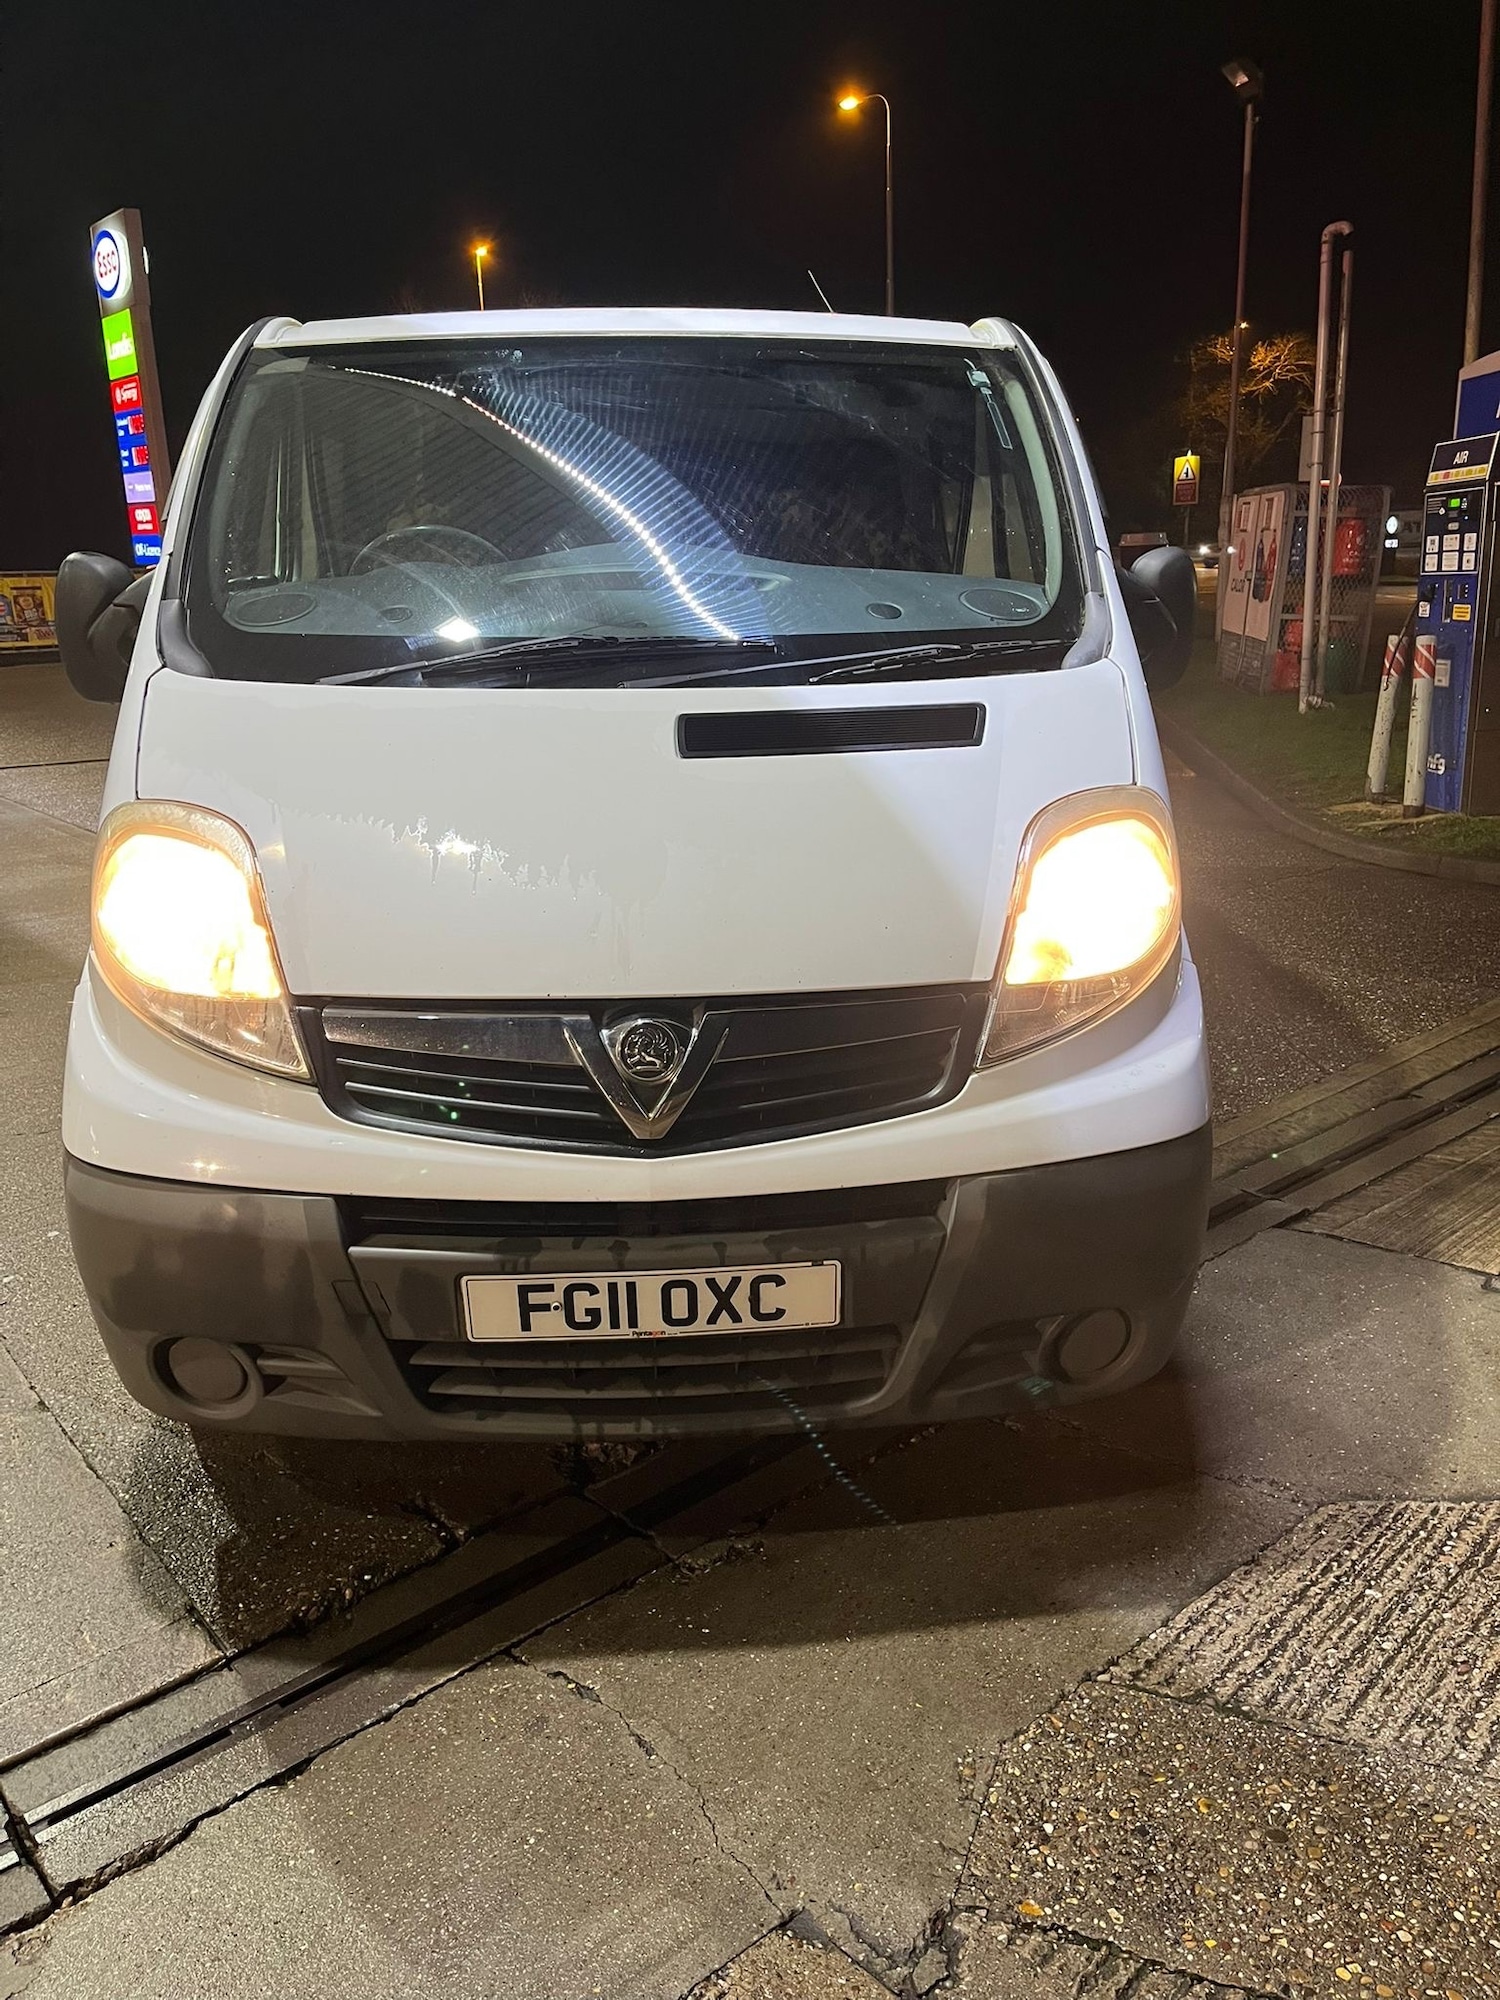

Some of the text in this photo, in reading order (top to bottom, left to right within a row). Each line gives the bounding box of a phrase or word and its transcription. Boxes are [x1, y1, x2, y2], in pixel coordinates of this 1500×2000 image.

[97, 251, 117, 278] Esso
[1453, 450, 1469, 465] AIR
[660, 1273, 788, 1329] OXC
